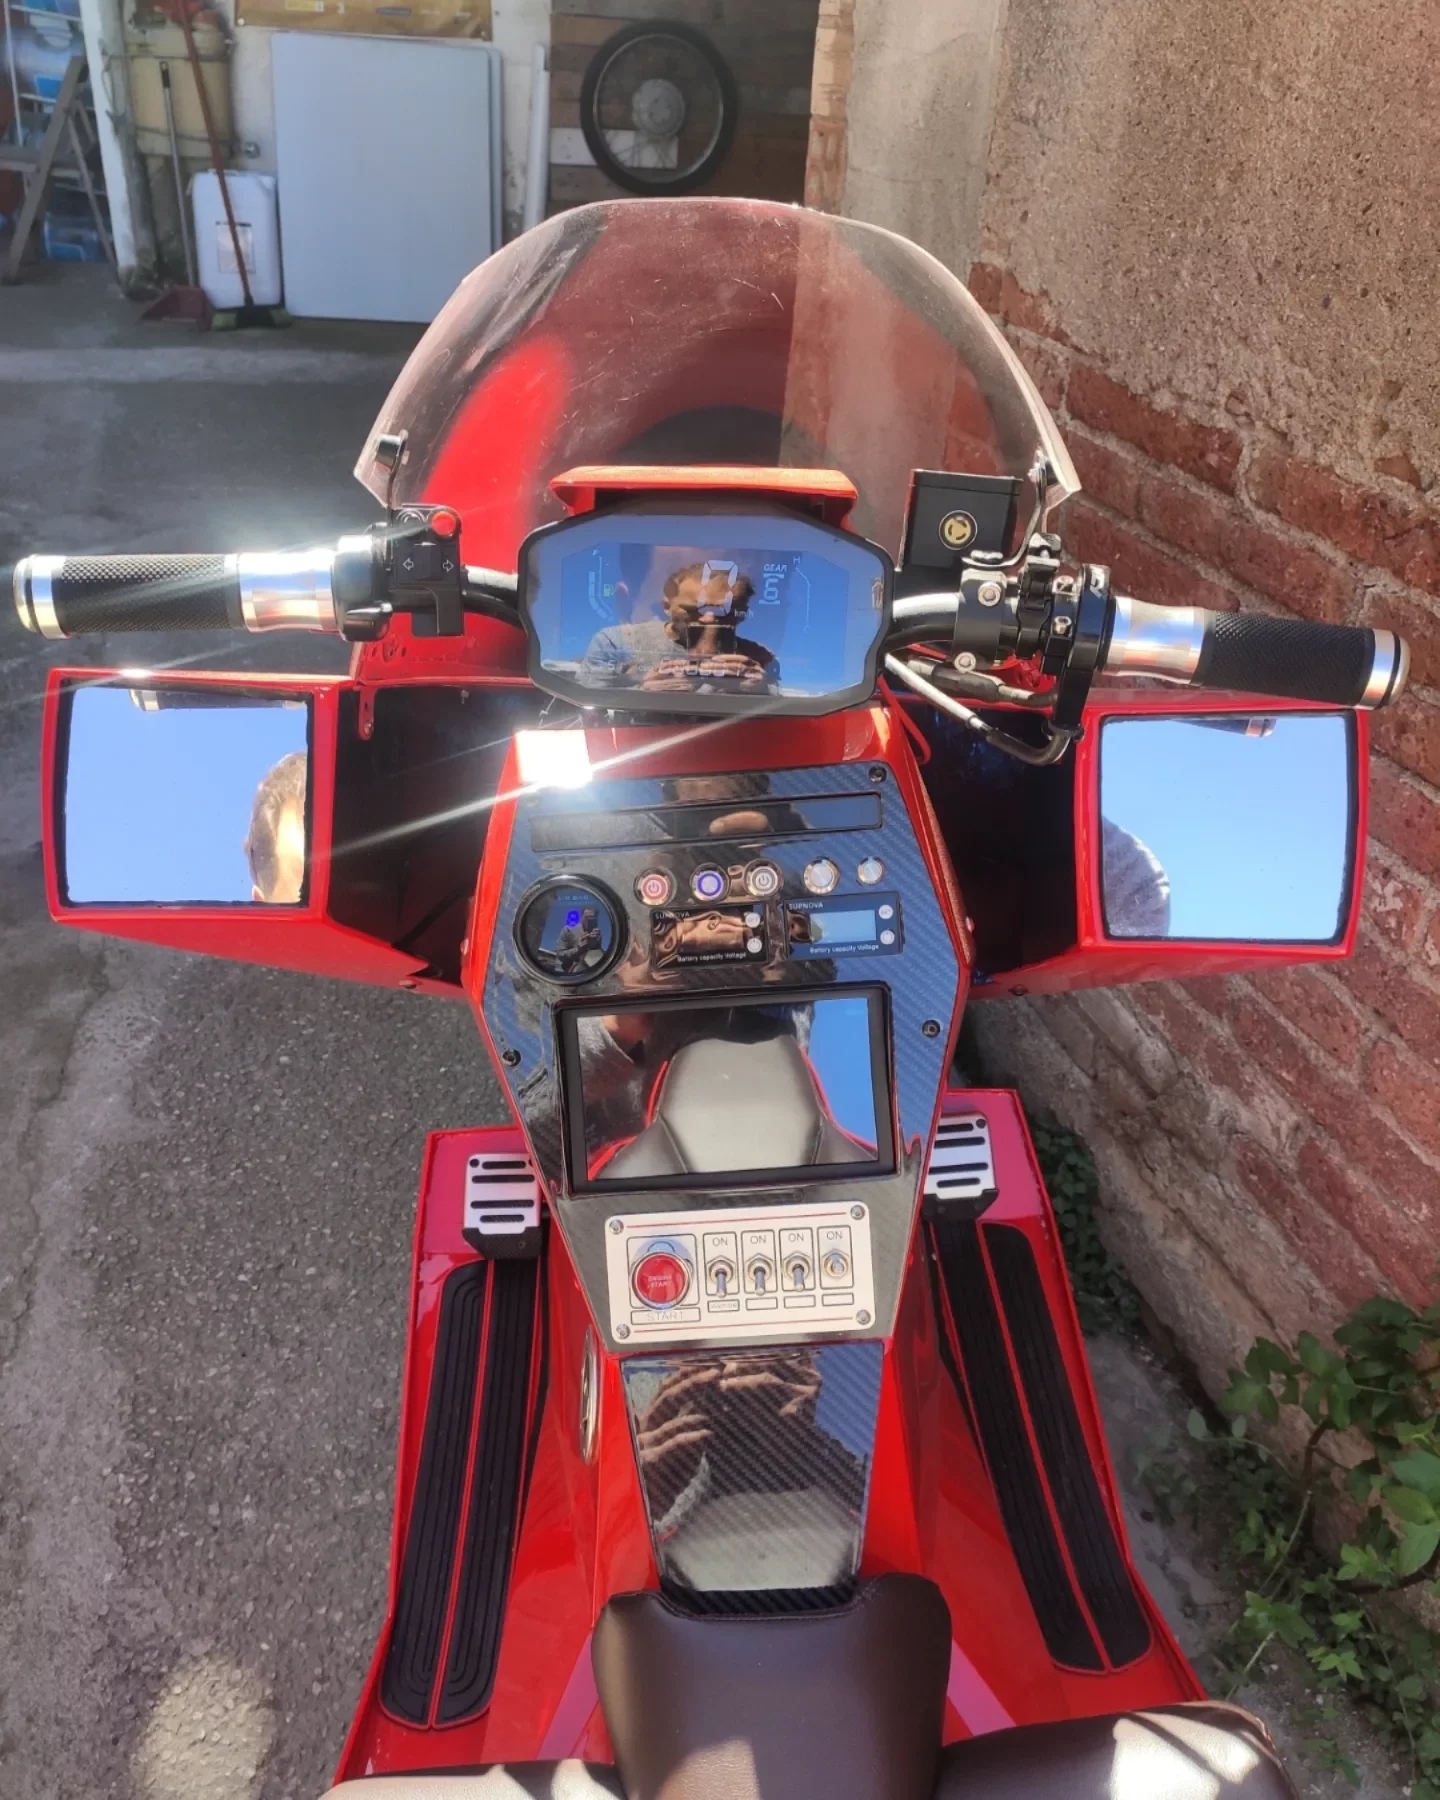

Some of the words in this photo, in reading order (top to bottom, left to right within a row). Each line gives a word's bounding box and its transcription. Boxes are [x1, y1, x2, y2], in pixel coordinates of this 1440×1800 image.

[793, 556, 800, 564] H
[763, 563, 788, 572] GEAR
[696, 559, 739, 616] 0
[734, 609, 754, 617] km/h
[788, 902, 824, 910] SUPNOVA
[655, 911, 690, 919] SUOVA
[832, 945, 856, 953] capacity
[700, 954, 723, 962] capacity
[750, 1235, 766, 1244] ON
[788, 1233, 804, 1243] ON
[826, 1231, 843, 1240] ON
[712, 1237, 728, 1246] ON
[648, 1274, 672, 1282] ENGINE
[647, 1311, 684, 1321] START
